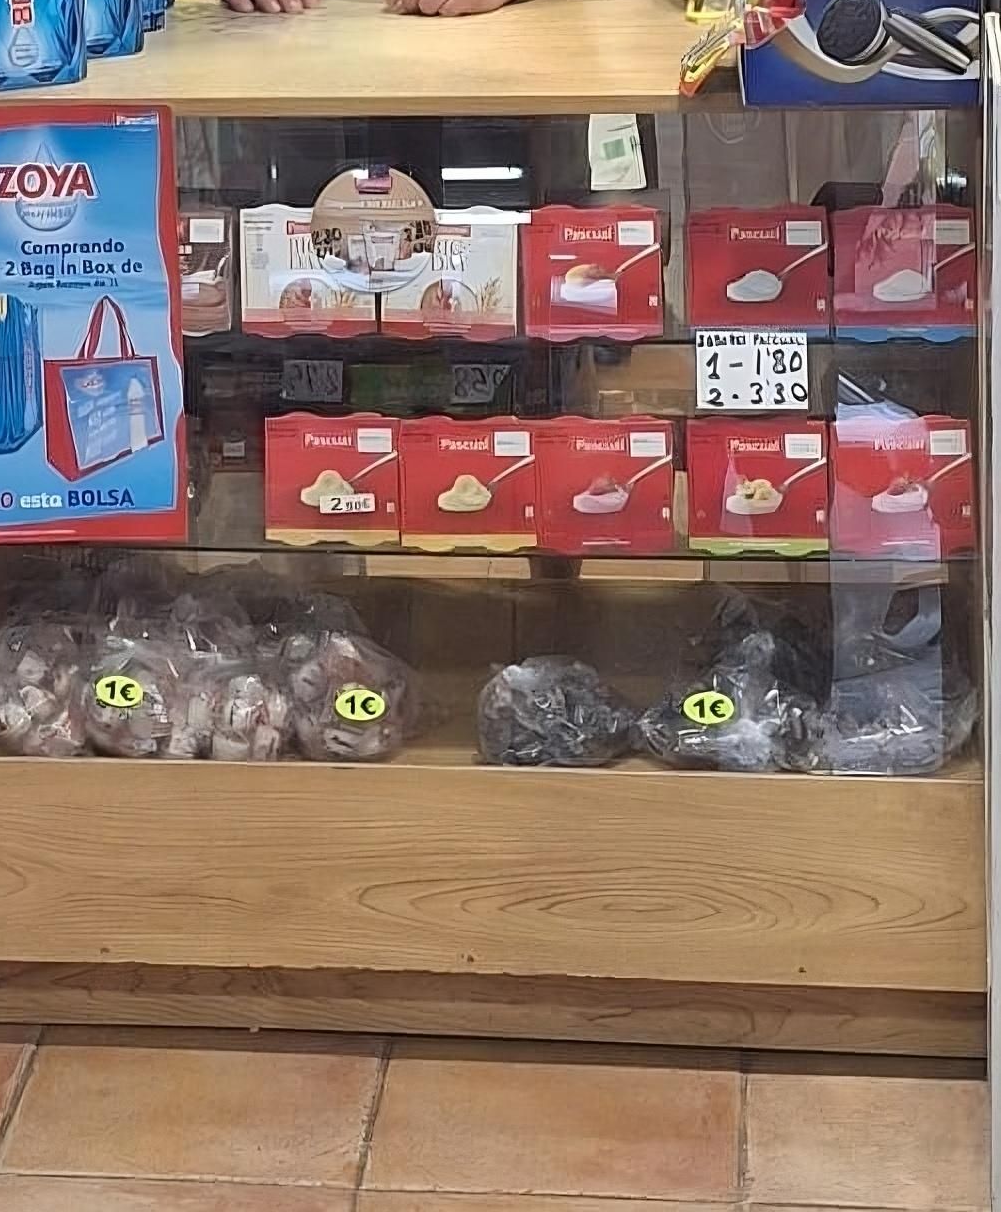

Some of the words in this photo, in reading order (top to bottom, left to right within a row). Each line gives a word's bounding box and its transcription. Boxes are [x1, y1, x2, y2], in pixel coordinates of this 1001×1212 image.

[20, 238, 125, 255] Comprando
[5, 261, 16, 276] 2
[20, 261, 55, 279] Bag
[82, 259, 117, 275] Box
[121, 258, 143, 274] de
[19, 492, 63, 509] esta
[67, 487, 135, 508] BOLSA
[105, 680, 135, 702] 1€
[345, 693, 377, 715] 1€
[693, 697, 726, 719] 1€
